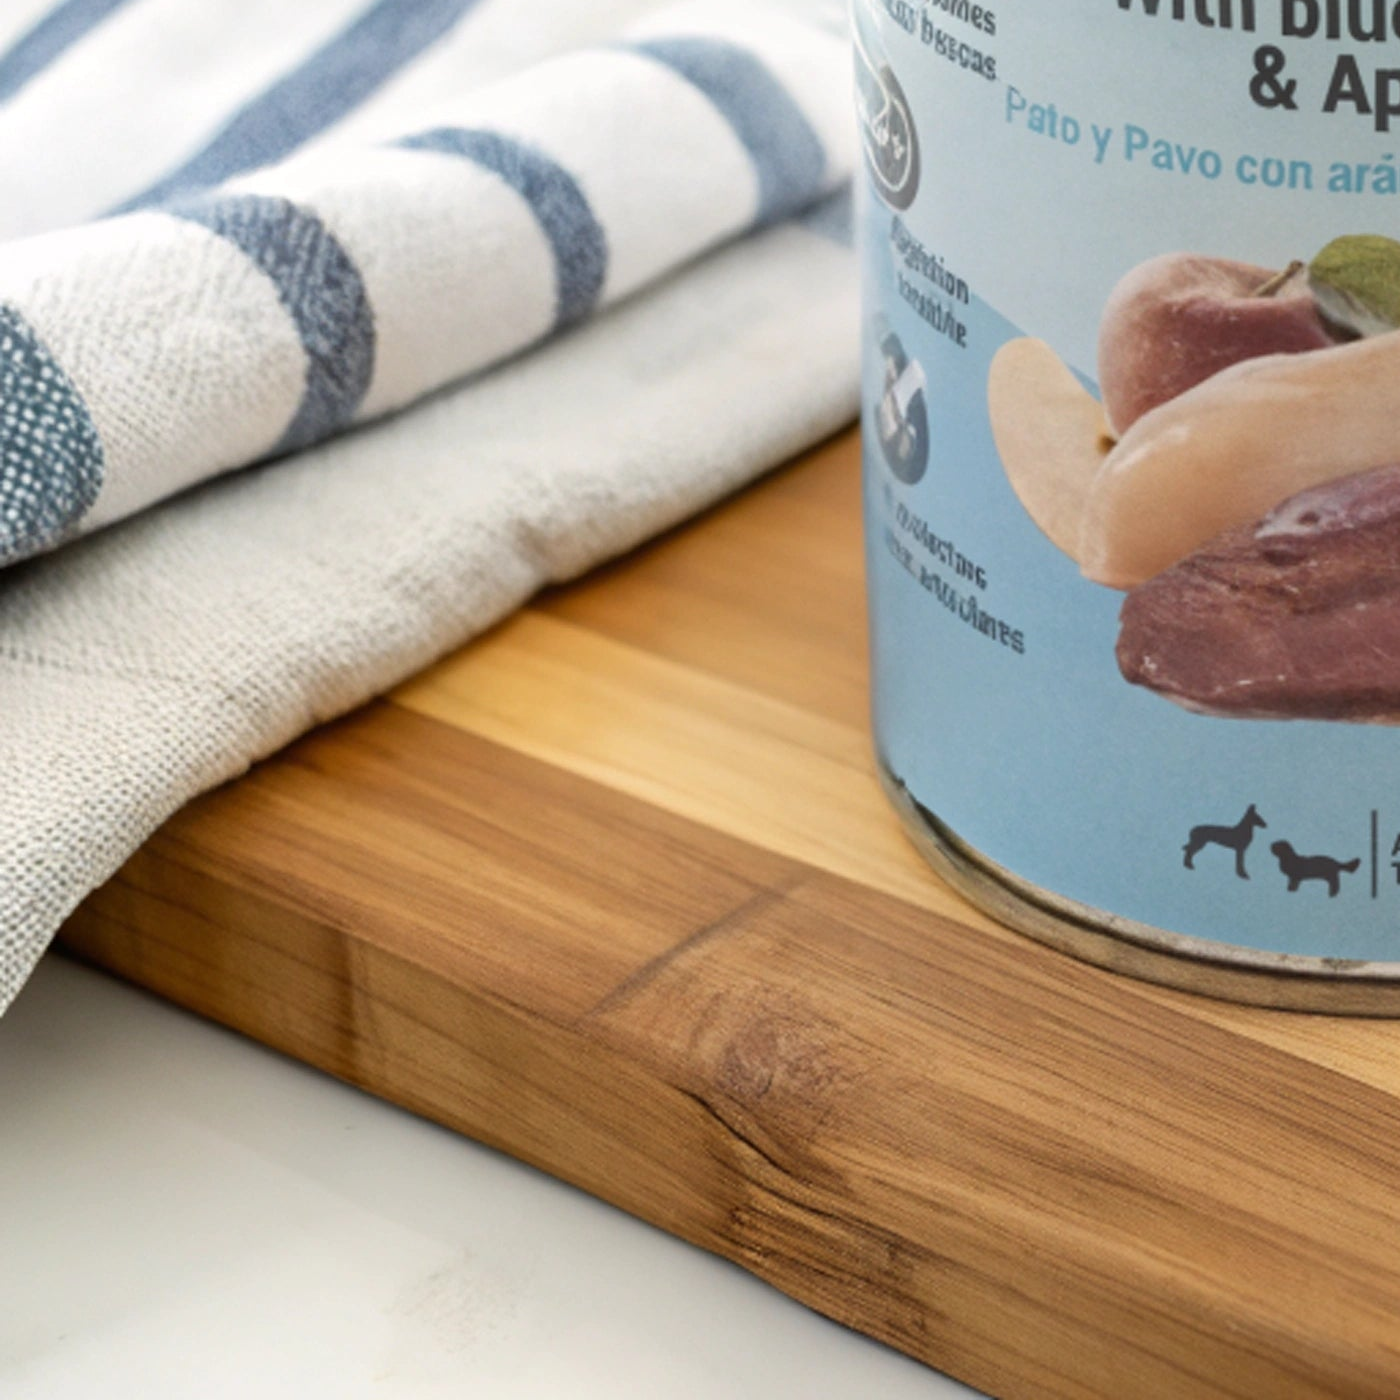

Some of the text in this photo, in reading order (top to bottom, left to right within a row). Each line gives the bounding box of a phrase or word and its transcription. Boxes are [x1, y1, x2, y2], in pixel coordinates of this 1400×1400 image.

[1248, 44, 1298, 110] &
[1005, 85, 1080, 146] Pato
[1091, 123, 1112, 165] y
[1124, 124, 1222, 180] Pavo
[1235, 154, 1313, 190] con
